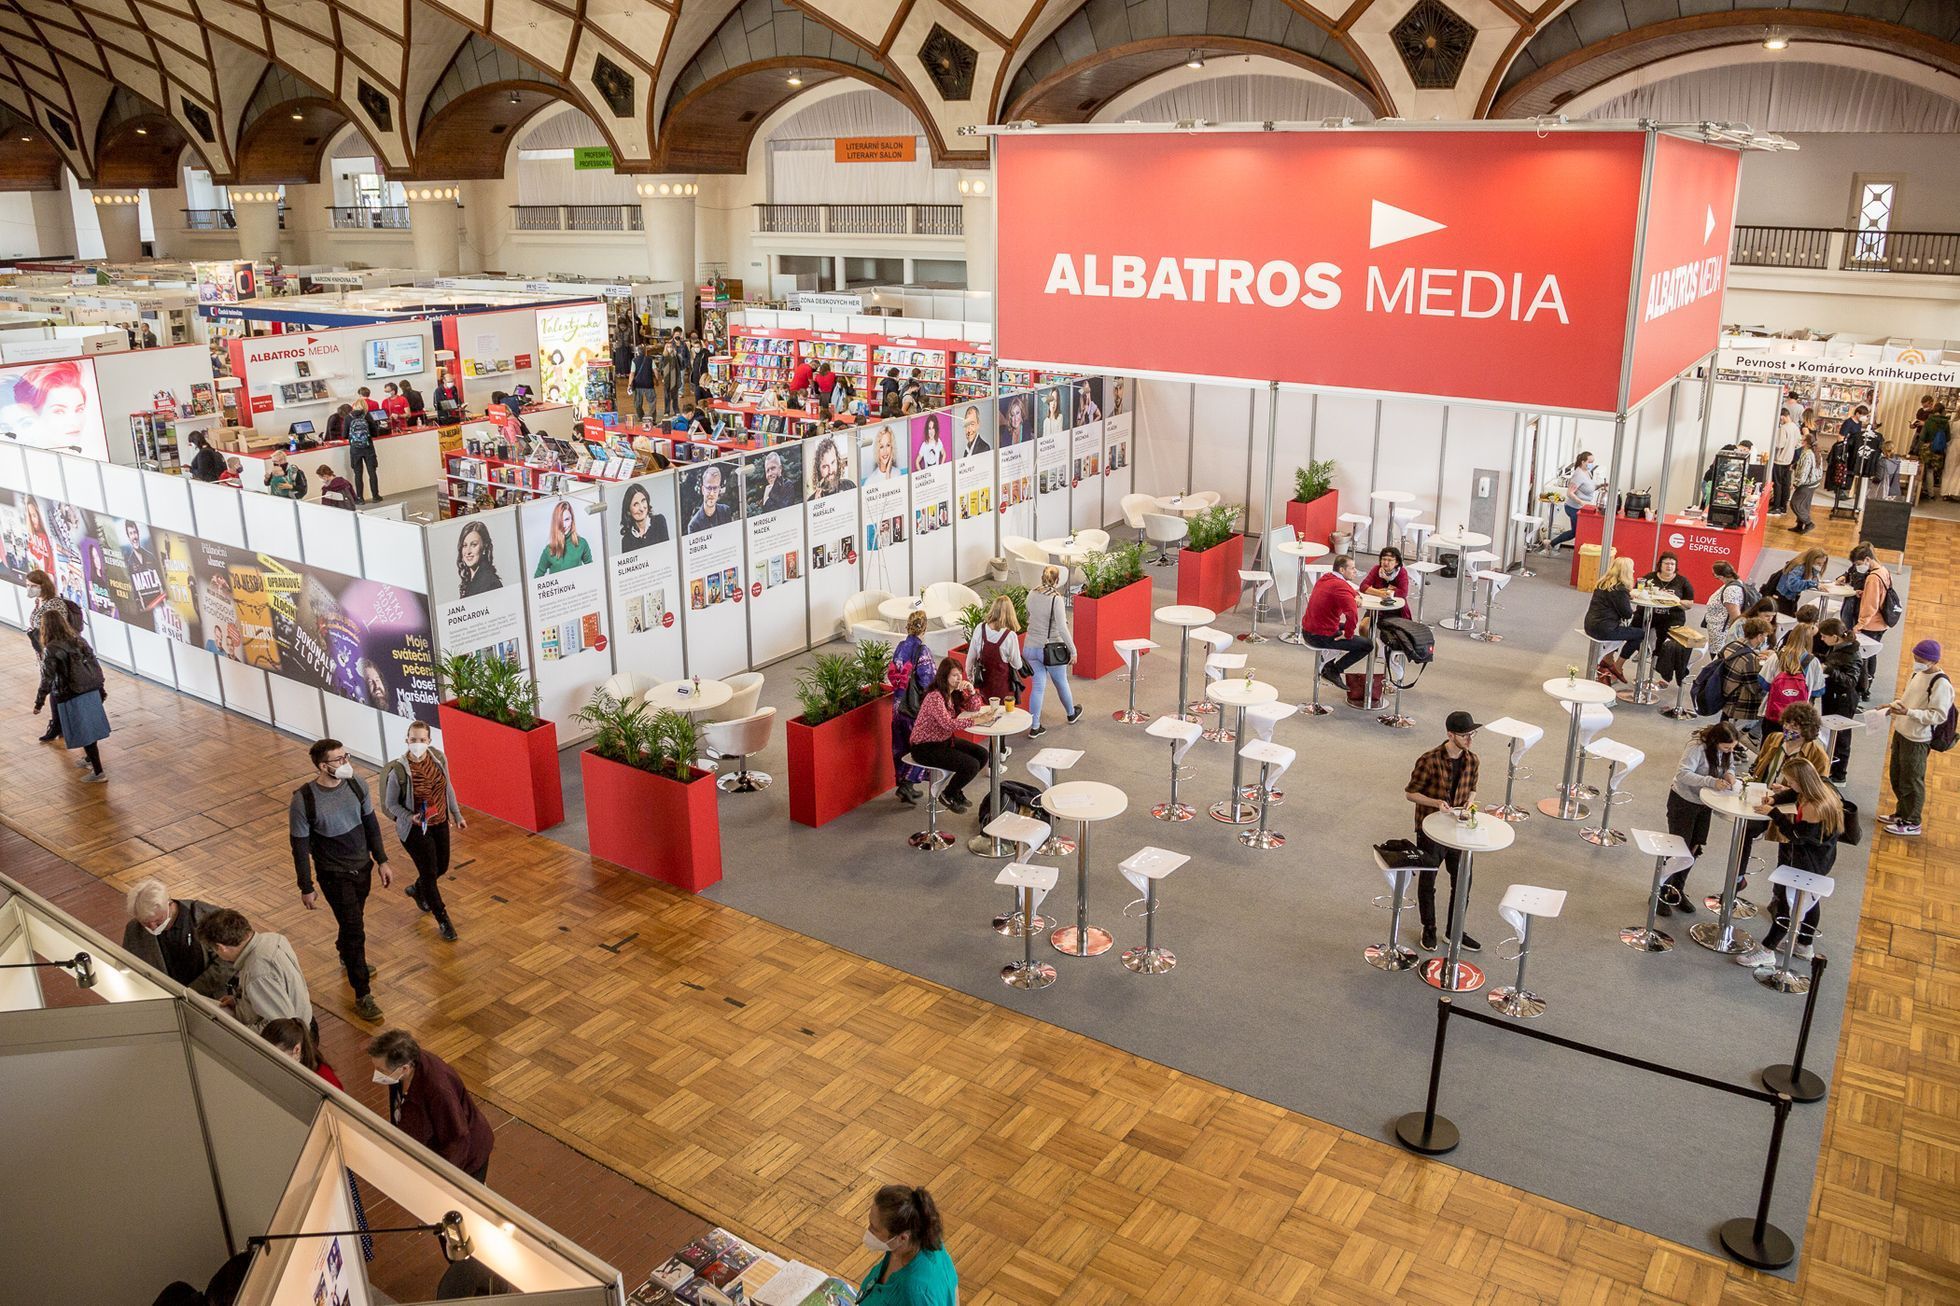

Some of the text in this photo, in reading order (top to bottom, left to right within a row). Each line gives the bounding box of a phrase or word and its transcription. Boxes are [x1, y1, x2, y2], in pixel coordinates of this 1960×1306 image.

[846, 141, 879, 150] LITERÁRNÍ
[1044, 253, 1570, 324] ALBATROS MEDIA
[1644, 255, 1723, 323] ALBATROS MEDIA
[250, 344, 340, 363] ALBATROS MEDIA
[1736, 356, 1955, 383] Pevnost Komárovo knihkupectví
[813, 502, 826, 510] JOSEF
[754, 516, 776, 527] MIROSLAV
[754, 527, 770, 536] MACEK
[688, 534, 712, 546] LADISLAV
[1696, 536, 1717, 545] LOVE
[689, 545, 708, 554] ZIBURA
[1689, 543, 1731, 555] ESPRESSO
[618, 556, 638, 566] MARGIT
[268, 576, 300, 589] OPRAVDOVÉ
[538, 579, 558, 590] RADKA
[538, 582, 576, 600] TŘEŠTÍKOVÁ
[376, 590, 398, 622] ROKU
[382, 584, 404, 620] MATKA
[374, 601, 388, 624] 2022
[448, 605, 466, 616] JANA
[448, 606, 490, 626] PONCAROVÁ
[406, 634, 428, 650] Moje
[392, 648, 432, 662] sváteční
[396, 688, 440, 704] Maršálek
